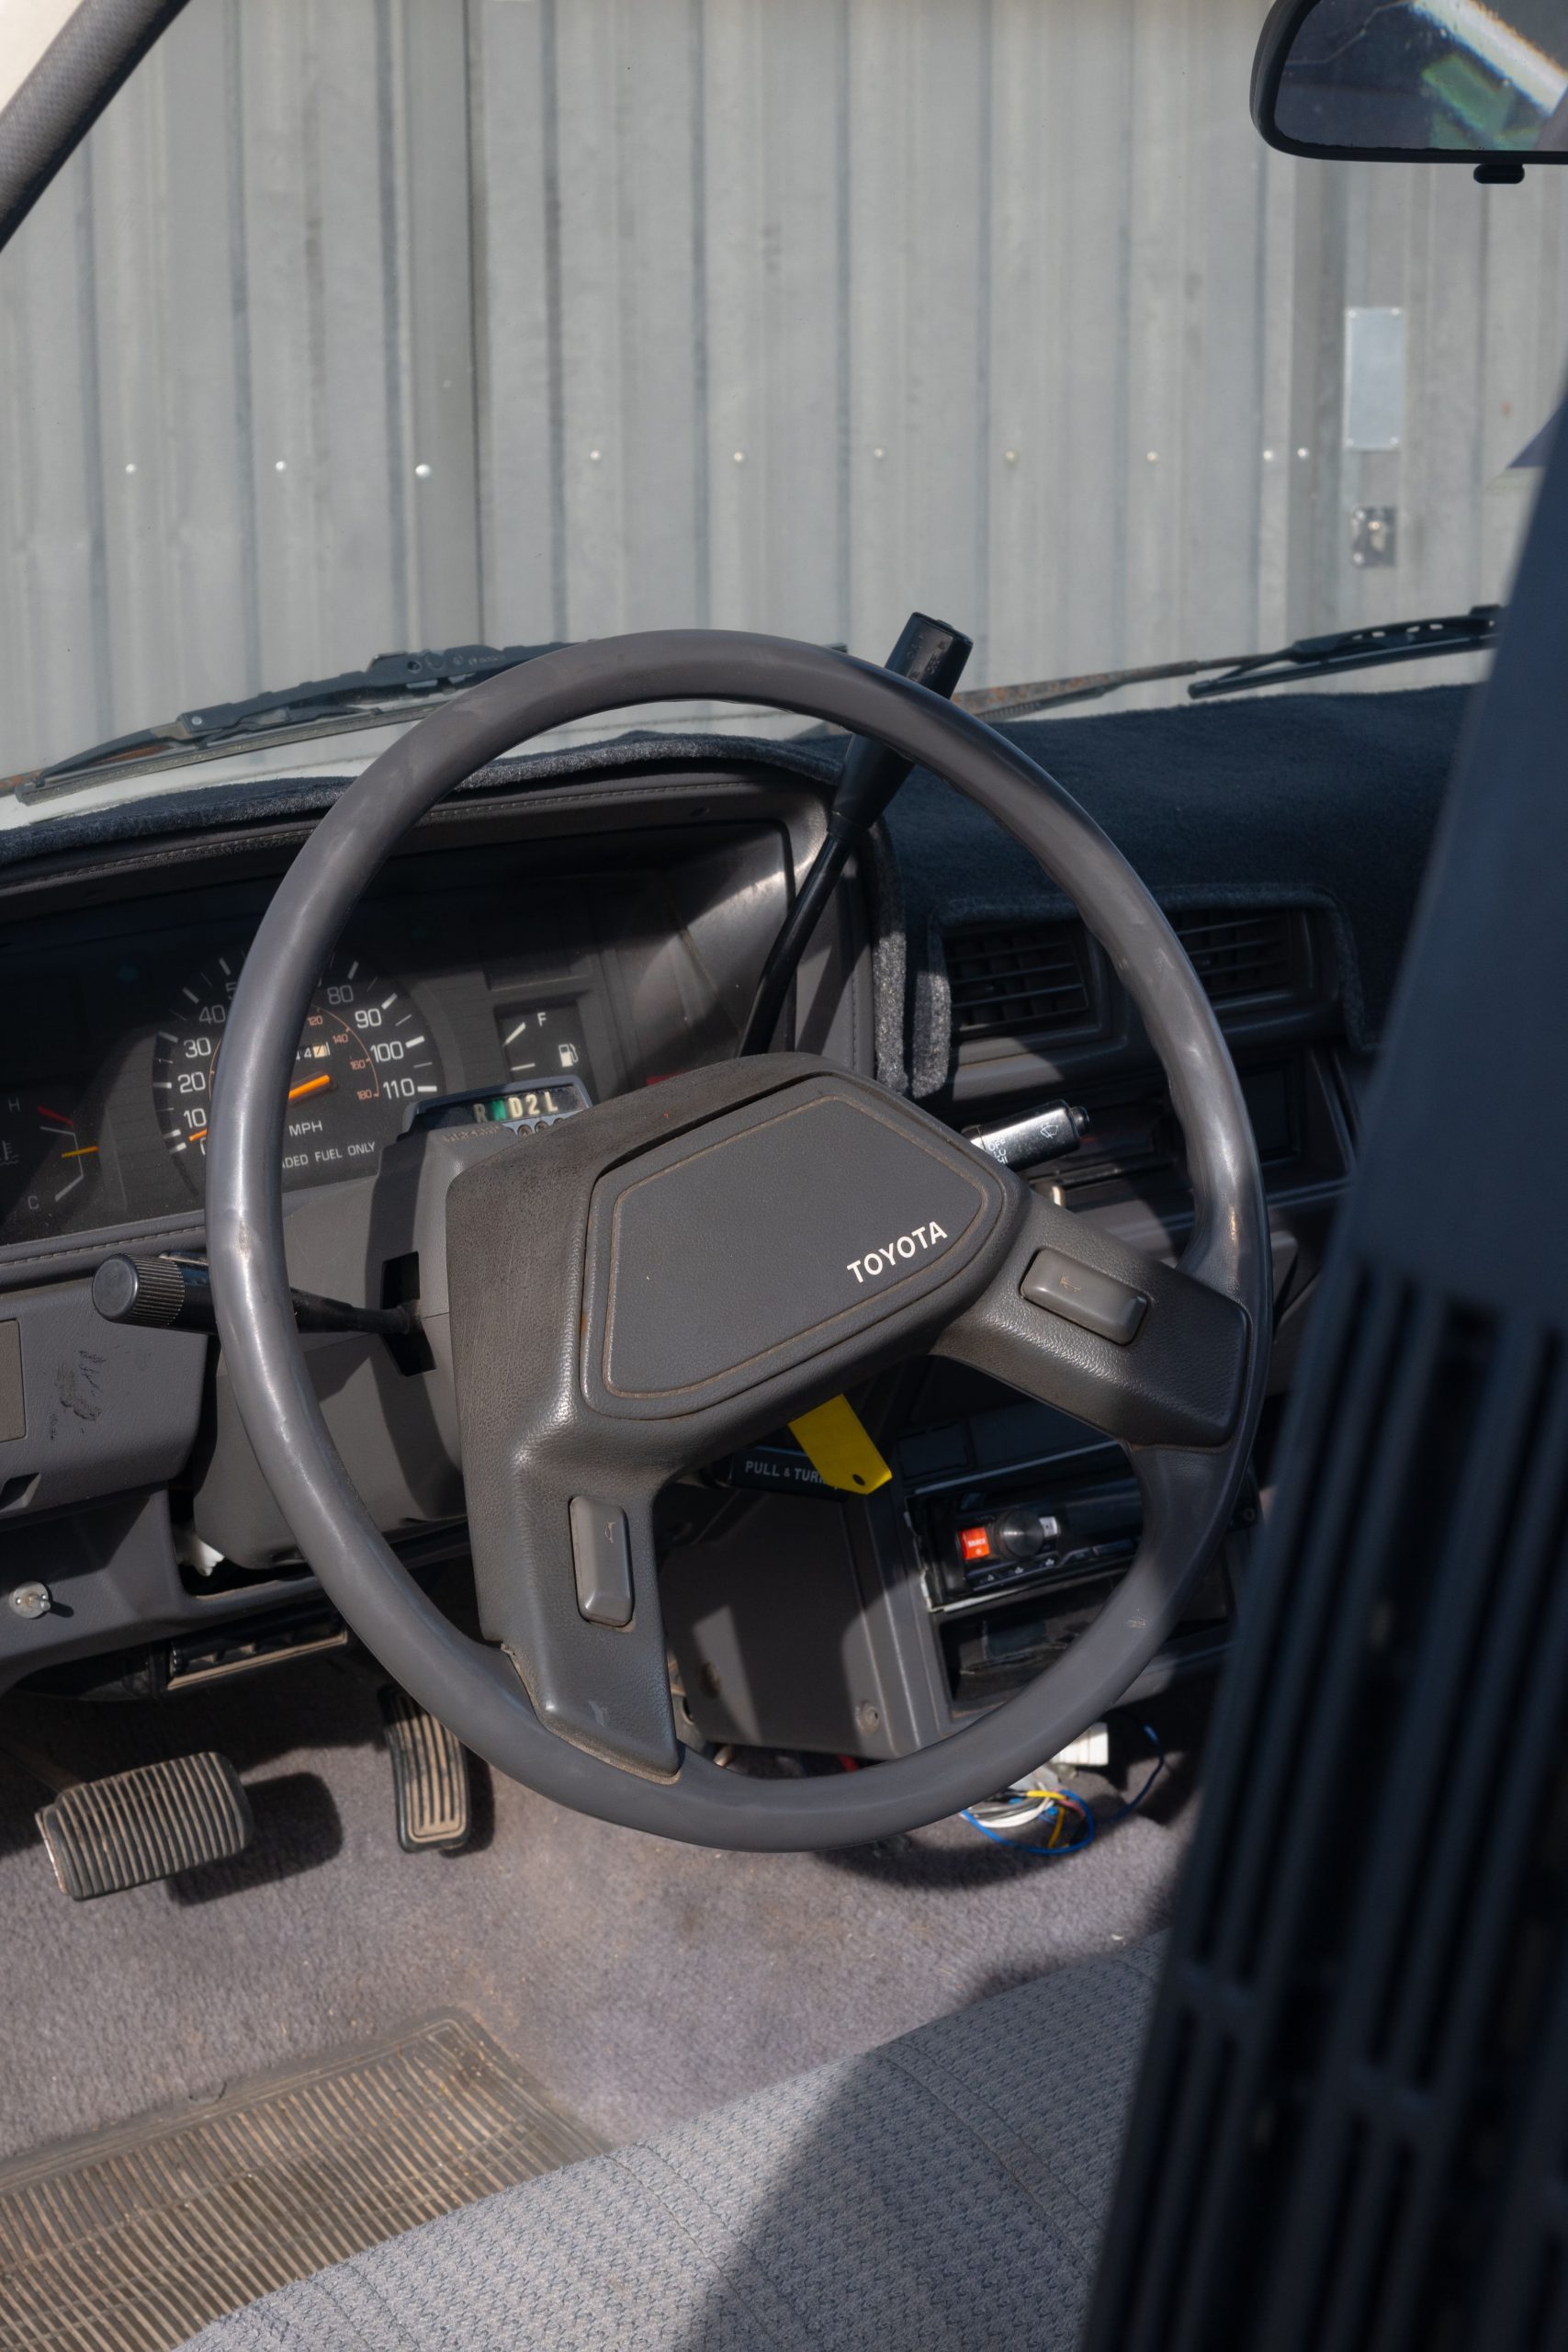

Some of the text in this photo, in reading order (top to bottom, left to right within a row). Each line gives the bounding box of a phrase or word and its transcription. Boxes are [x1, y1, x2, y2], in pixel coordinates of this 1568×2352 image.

[327, 985, 354, 1005] 80
[198, 1004, 226, 1024] 40
[308, 1015, 323, 1025] 120
[355, 1008, 382, 1028] 90
[536, 1012, 547, 1026] F
[184, 1036, 211, 1058] 30
[333, 1034, 349, 1045] 140
[370, 1041, 404, 1063] 100
[350, 1059, 366, 1070] 160
[177, 1071, 206, 1093] 20
[383, 1078, 415, 1099] 110
[8, 1097, 20, 1113] H
[356, 1090, 372, 1100] 180
[473, 1103, 488, 1123] R
[508, 1096, 524, 1118] D
[525, 1094, 540, 1115] 2
[544, 1091, 558, 1113] L
[183, 1108, 207, 1128] 10
[288, 1120, 323, 1136] MPH
[314, 1148, 343, 1162] FUEL
[347, 1141, 376, 1156] ONLY
[987, 1138, 1006, 1151] OFF
[28, 1195, 39, 1209] C
[846, 1221, 948, 1283] TOYOTA
[745, 1461, 780, 1476] PULL
[784, 1467, 791, 1477] &
